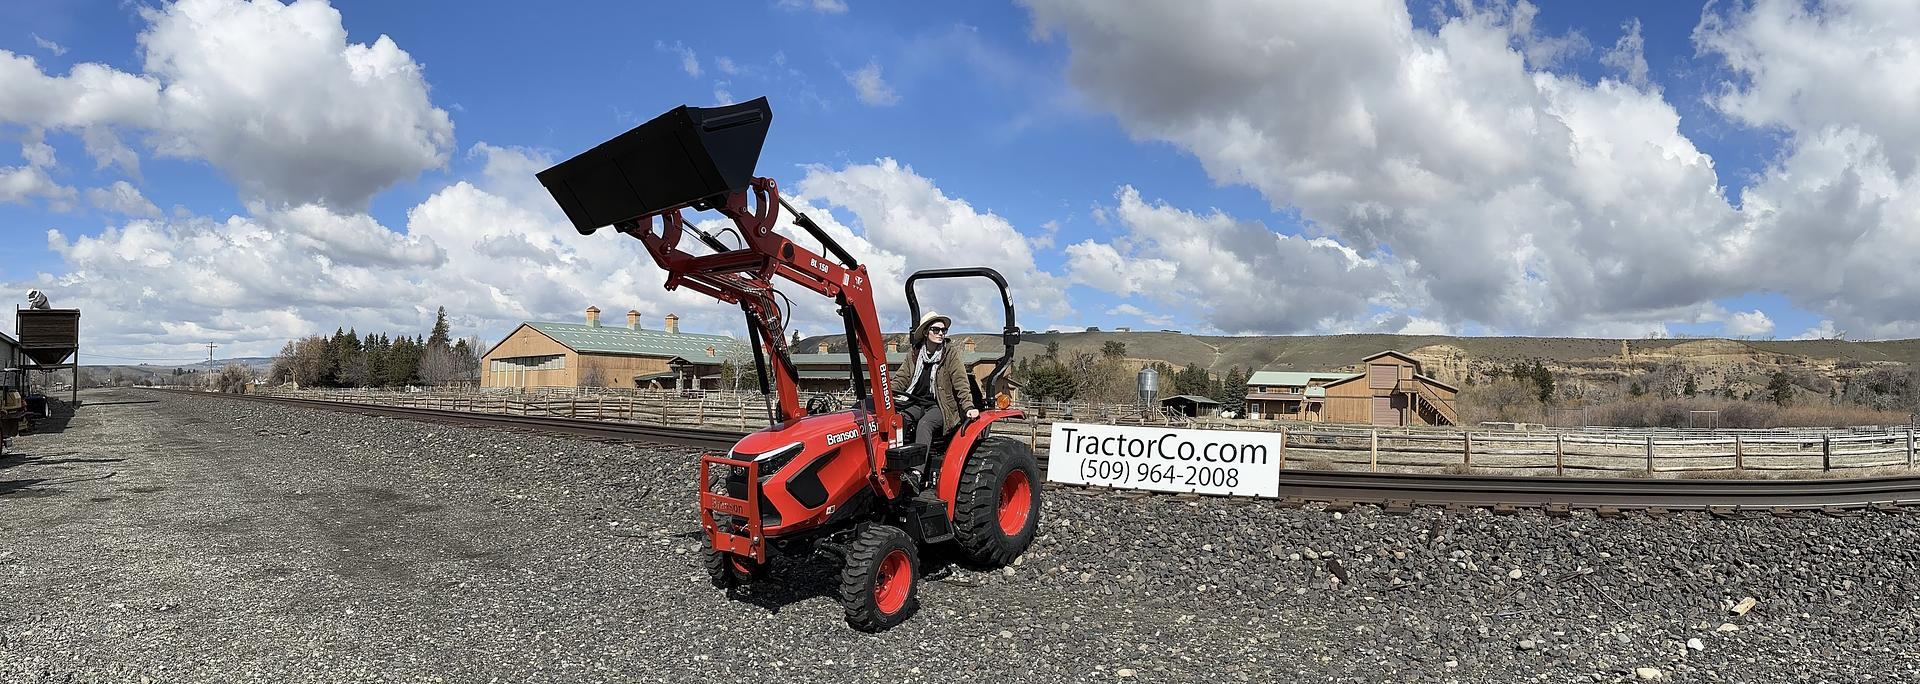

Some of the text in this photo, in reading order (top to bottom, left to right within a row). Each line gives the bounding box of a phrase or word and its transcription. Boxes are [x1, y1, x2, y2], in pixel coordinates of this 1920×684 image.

[810, 258, 829, 273] BL 150
[879, 363, 891, 410] Branson
[826, 428, 859, 446] Branson
[1061, 427, 1268, 465] TractorCo.com
[1080, 457, 1239, 488] (509) 964-2008
